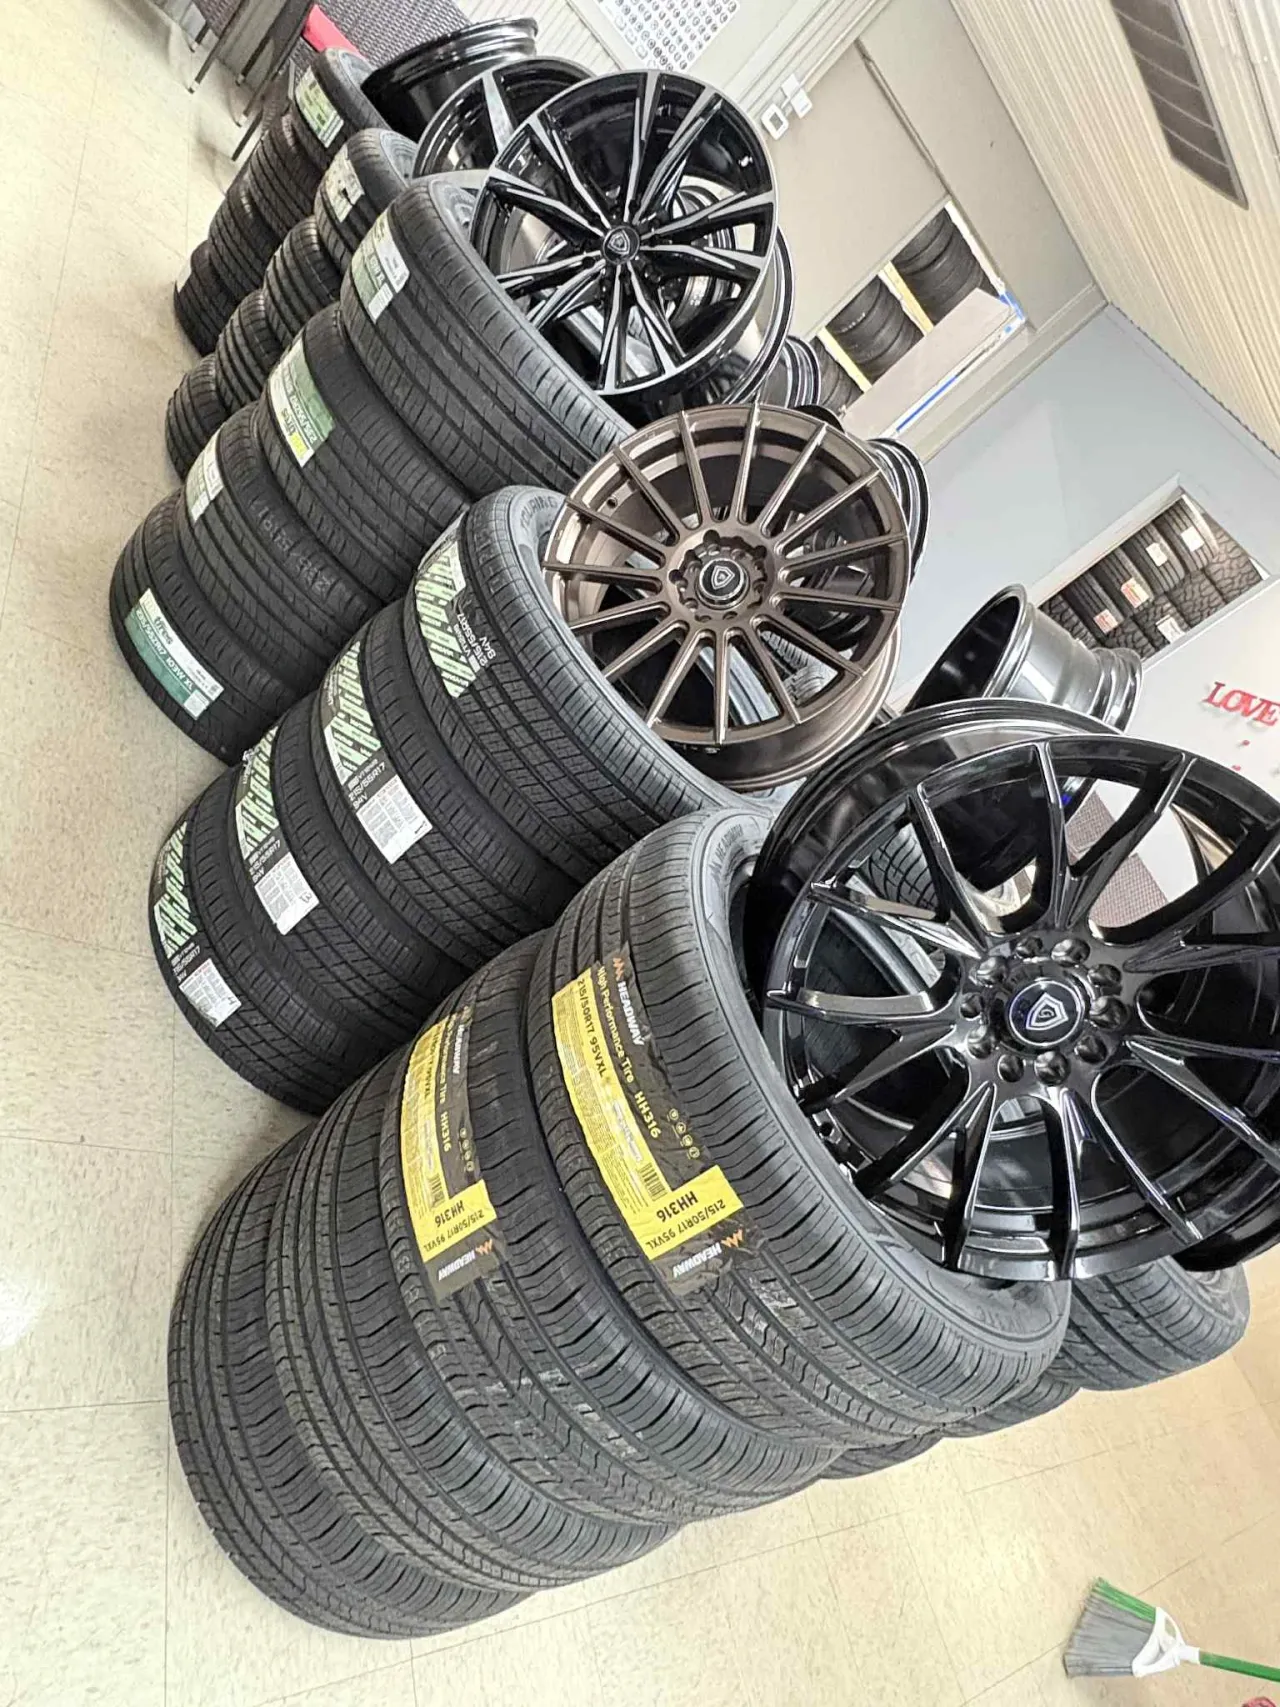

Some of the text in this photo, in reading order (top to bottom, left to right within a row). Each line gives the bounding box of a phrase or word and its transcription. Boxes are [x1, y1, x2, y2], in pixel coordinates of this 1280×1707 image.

[457, 613, 488, 666] 215/55R17
[1201, 681, 1280, 726] LOVE
[348, 761, 386, 801] 215/55R17
[597, 966, 606, 987] High
[577, 979, 608, 1078] 215/50R17 95VXL
[601, 987, 625, 1059] Performance
[617, 980, 645, 1046] HEADWAY
[621, 1058, 635, 1083] Tire
[440, 1111, 453, 1152] HH316
[634, 1090, 662, 1139] HH316
[435, 1200, 465, 1228] HH316
[447, 1209, 485, 1239] 215/50R17
[644, 1199, 727, 1251] 215/50R17 95VXL
[656, 1190, 699, 1223] HH316
[438, 1249, 476, 1281] HEADWAY
[672, 1241, 723, 1279] HEADWAY
